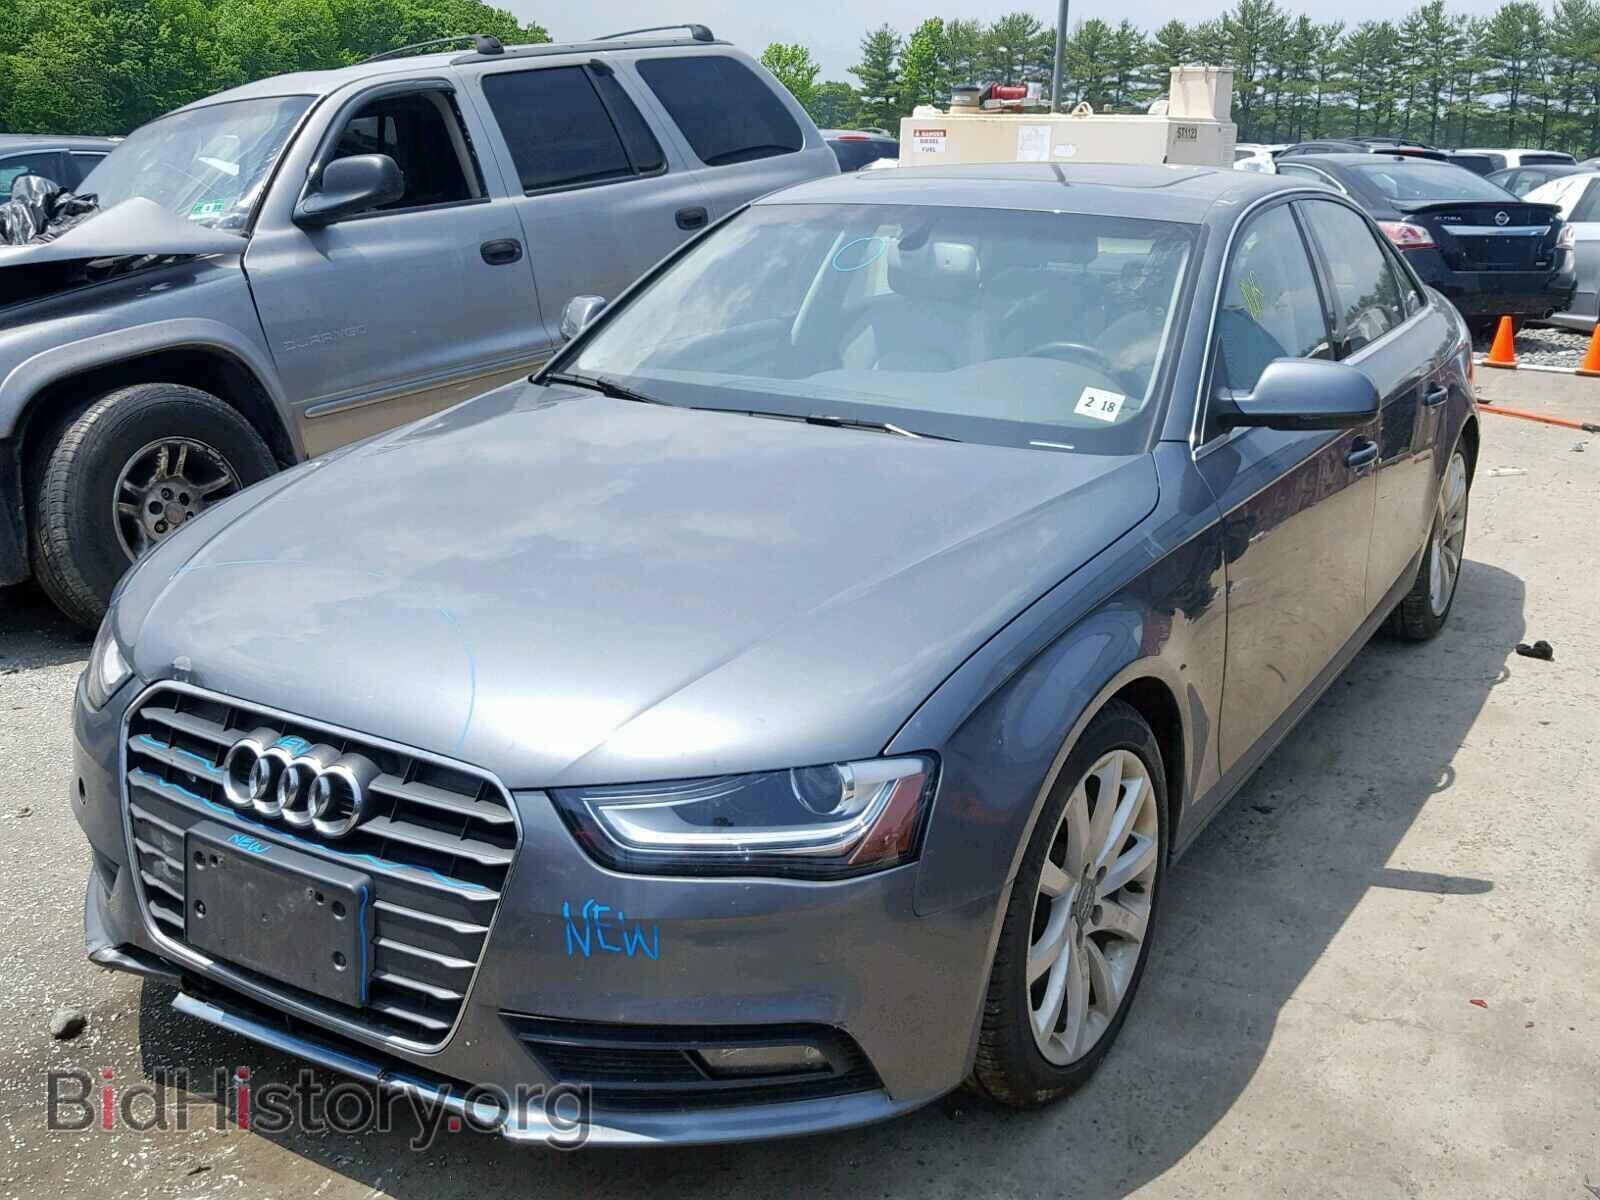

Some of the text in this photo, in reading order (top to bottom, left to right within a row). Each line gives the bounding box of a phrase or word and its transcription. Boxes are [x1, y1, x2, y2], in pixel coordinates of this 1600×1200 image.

[1084, 396, 1116, 413] 2 18
[228, 833, 272, 854] NEW
[562, 898, 660, 960] NEW
